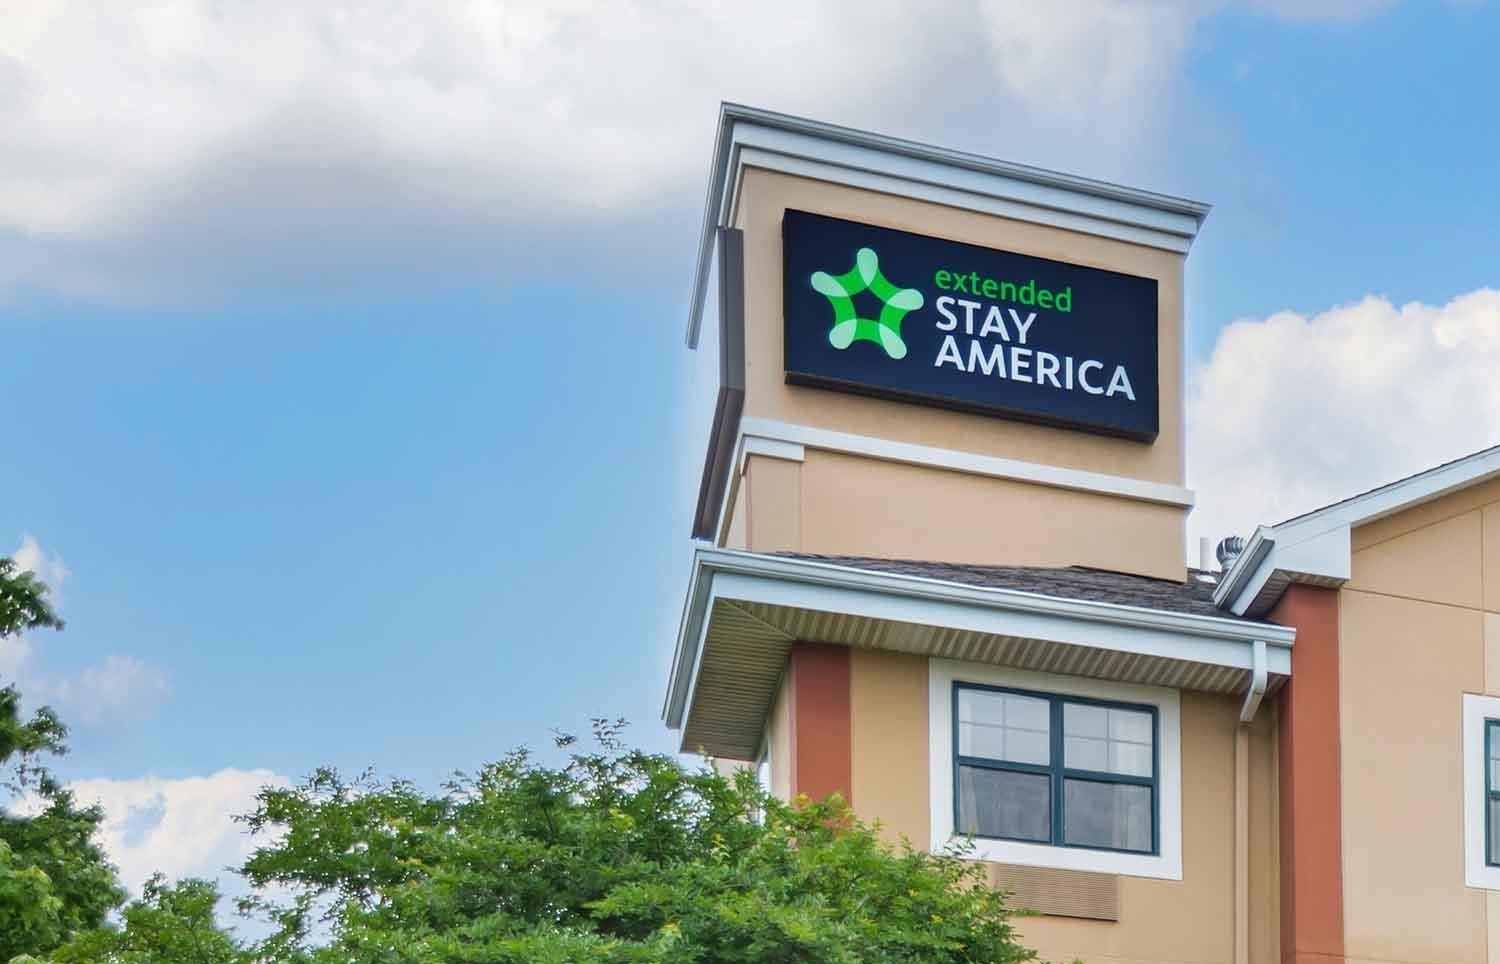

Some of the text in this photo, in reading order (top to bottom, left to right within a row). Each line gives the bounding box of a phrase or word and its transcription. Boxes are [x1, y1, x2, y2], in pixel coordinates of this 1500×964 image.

[935, 268, 1072, 313] extended
[935, 295, 1038, 344] STAY
[934, 335, 1136, 401] AMERICA
